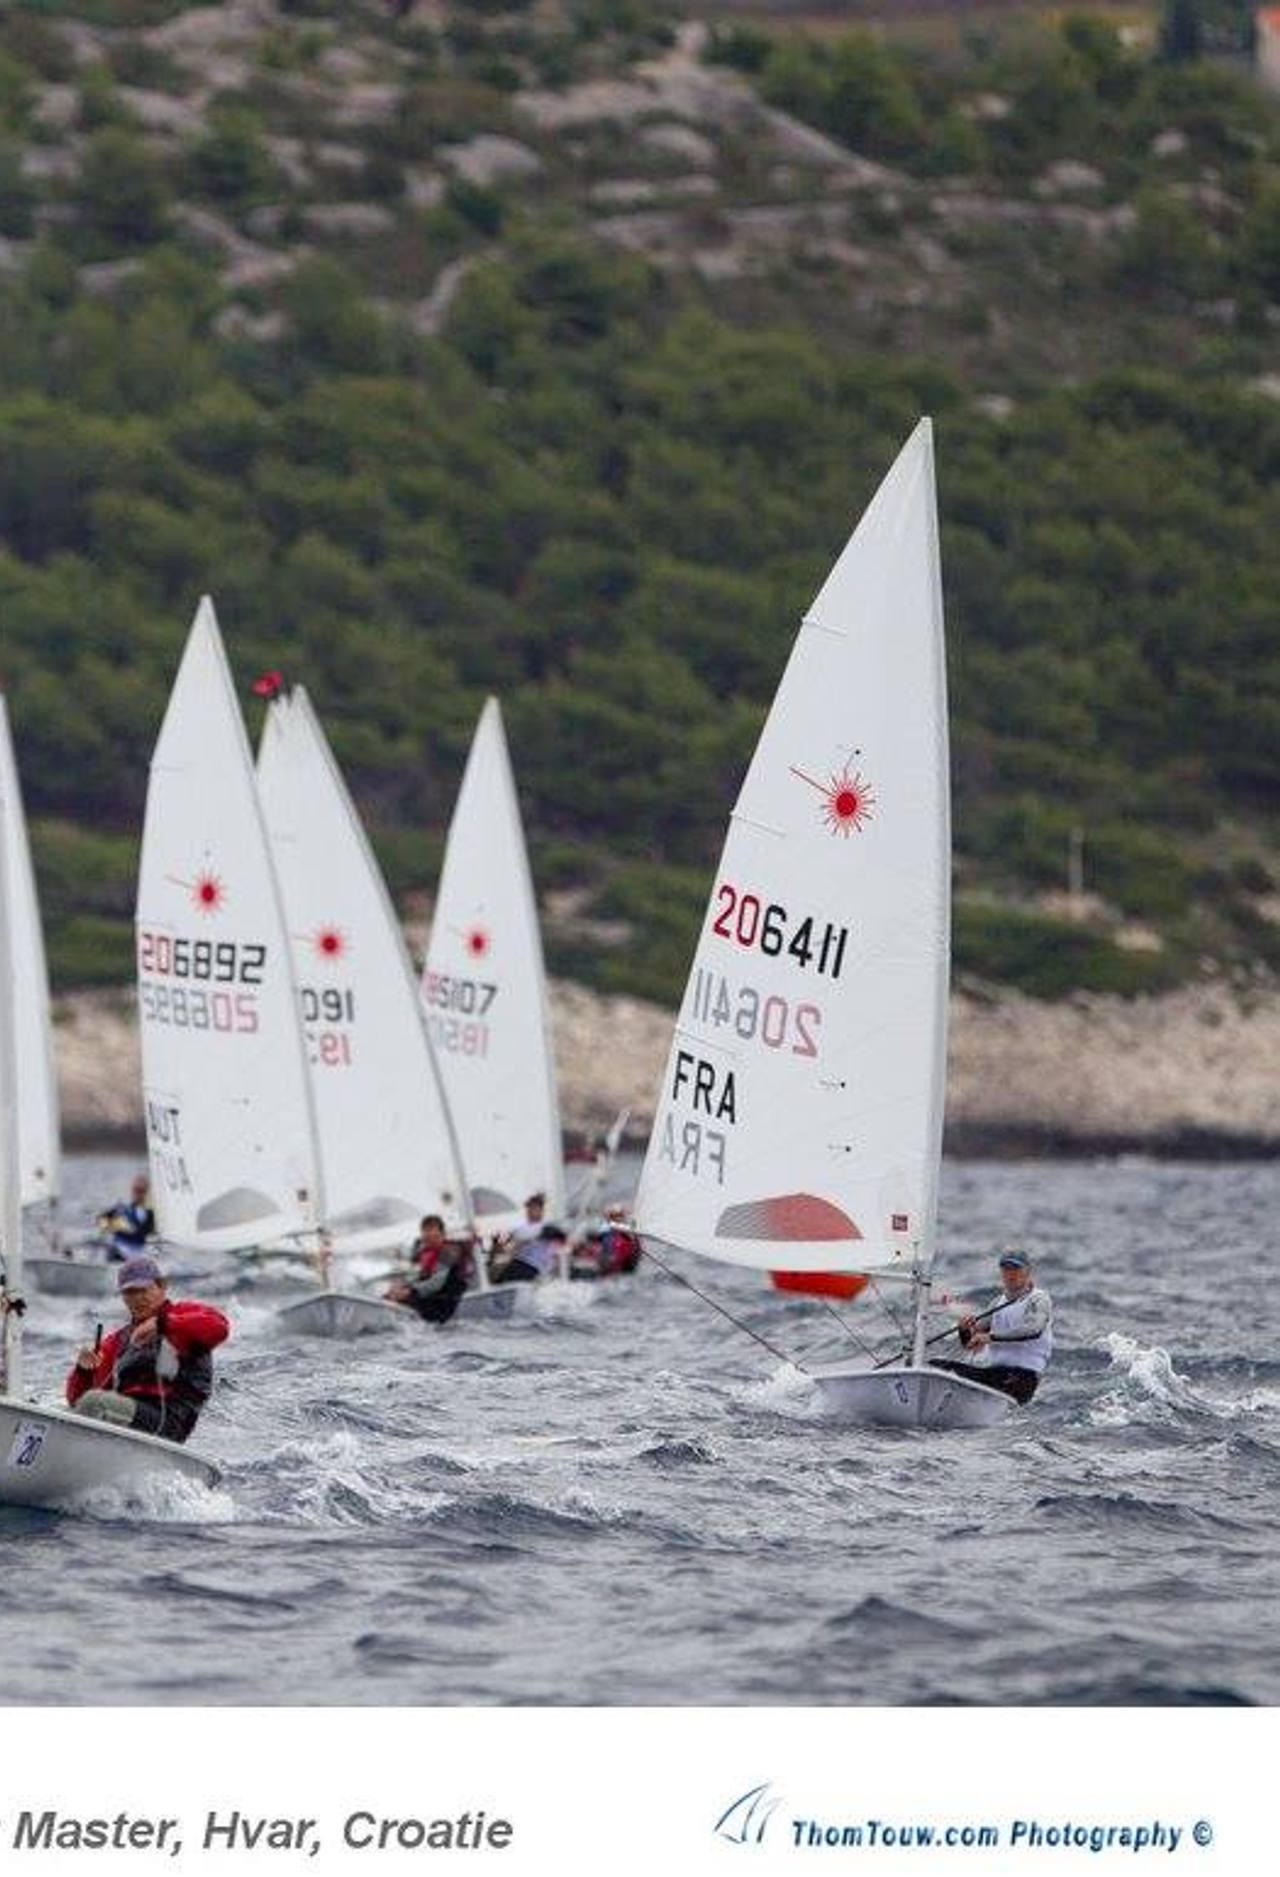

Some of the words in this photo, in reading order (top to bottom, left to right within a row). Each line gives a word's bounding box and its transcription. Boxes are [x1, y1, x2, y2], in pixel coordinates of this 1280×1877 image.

[142, 933, 266, 984] 206892
[713, 884, 848, 979] 206411
[672, 1051, 737, 1125] FRA
